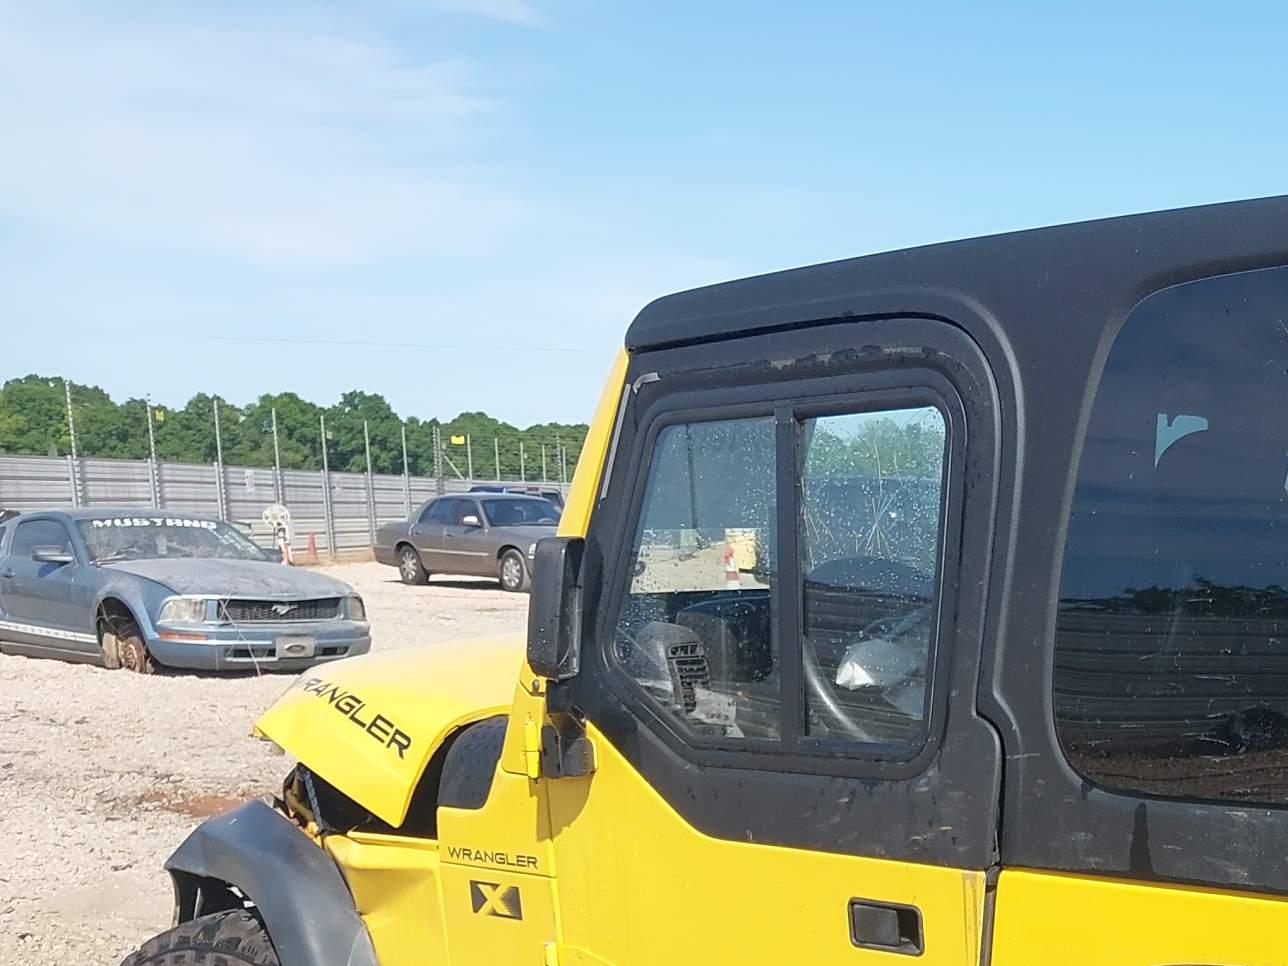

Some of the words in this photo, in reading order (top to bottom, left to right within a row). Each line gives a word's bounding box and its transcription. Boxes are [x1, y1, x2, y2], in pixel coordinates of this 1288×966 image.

[92, 517, 217, 529] MUSTANG
[448, 846, 538, 869] WRANGLER
[471, 880, 523, 921] X
